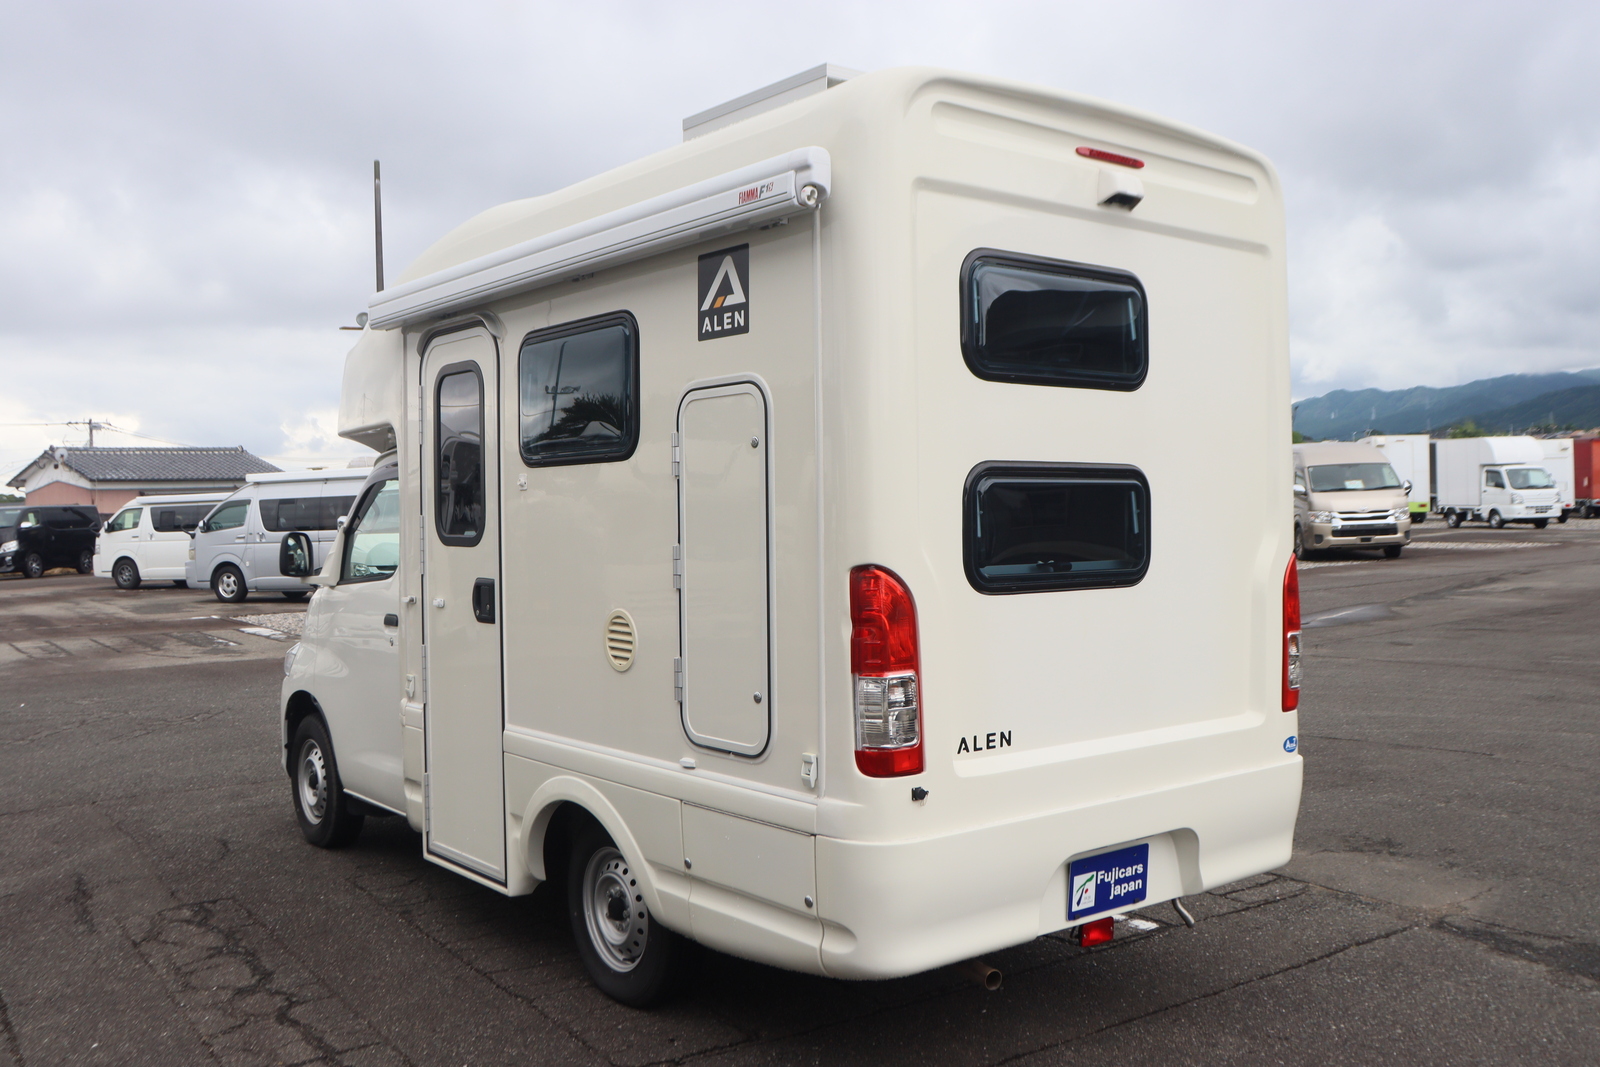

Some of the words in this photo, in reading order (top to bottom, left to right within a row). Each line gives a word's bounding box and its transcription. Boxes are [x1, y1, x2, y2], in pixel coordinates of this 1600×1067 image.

[738, 187, 758, 205] FIAMMA
[702, 309, 744, 333] ALEN
[957, 730, 1011, 754] ALEN
[1097, 863, 1144, 884] Fujicars
[1109, 879, 1142, 900] japan
